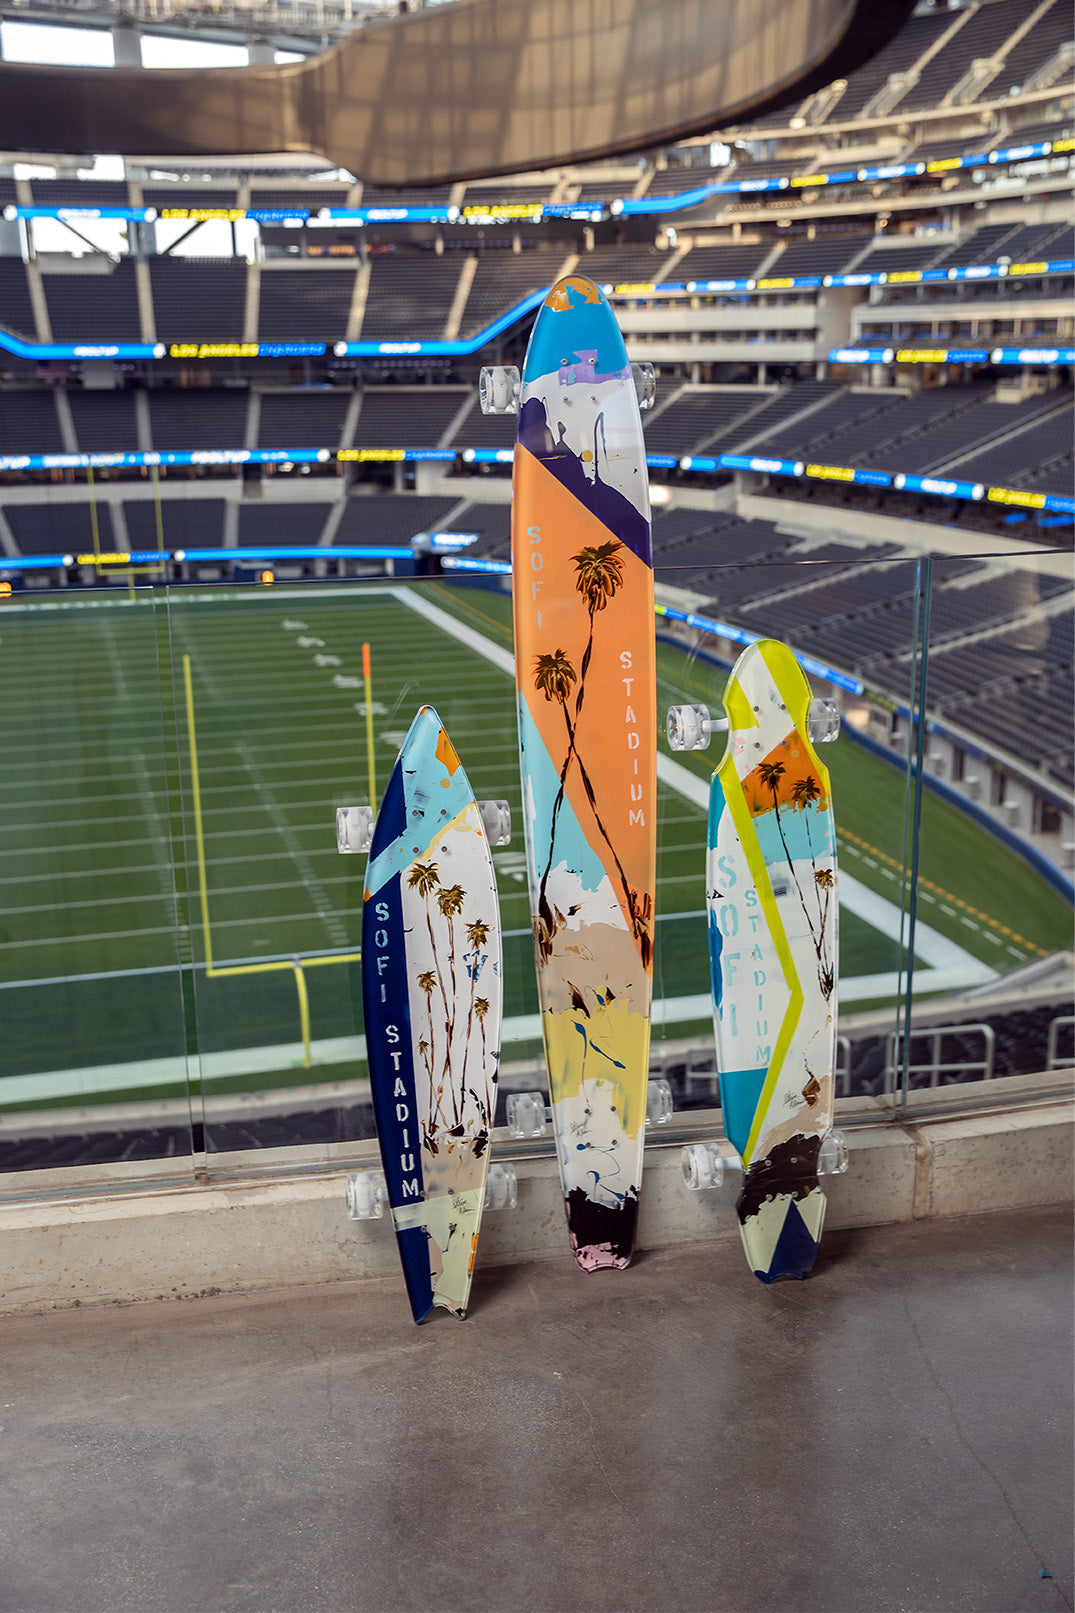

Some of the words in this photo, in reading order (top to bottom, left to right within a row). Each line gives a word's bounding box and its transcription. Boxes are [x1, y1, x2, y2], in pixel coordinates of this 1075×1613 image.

[526, 525, 544, 629] SOFI
[619, 651, 646, 828] STADIUM
[717, 855, 742, 1038] SOFI
[744, 889, 772, 1064] STADIUM
[374, 901, 390, 1004] SOFI
[385, 1024, 420, 1199] STADIUM
